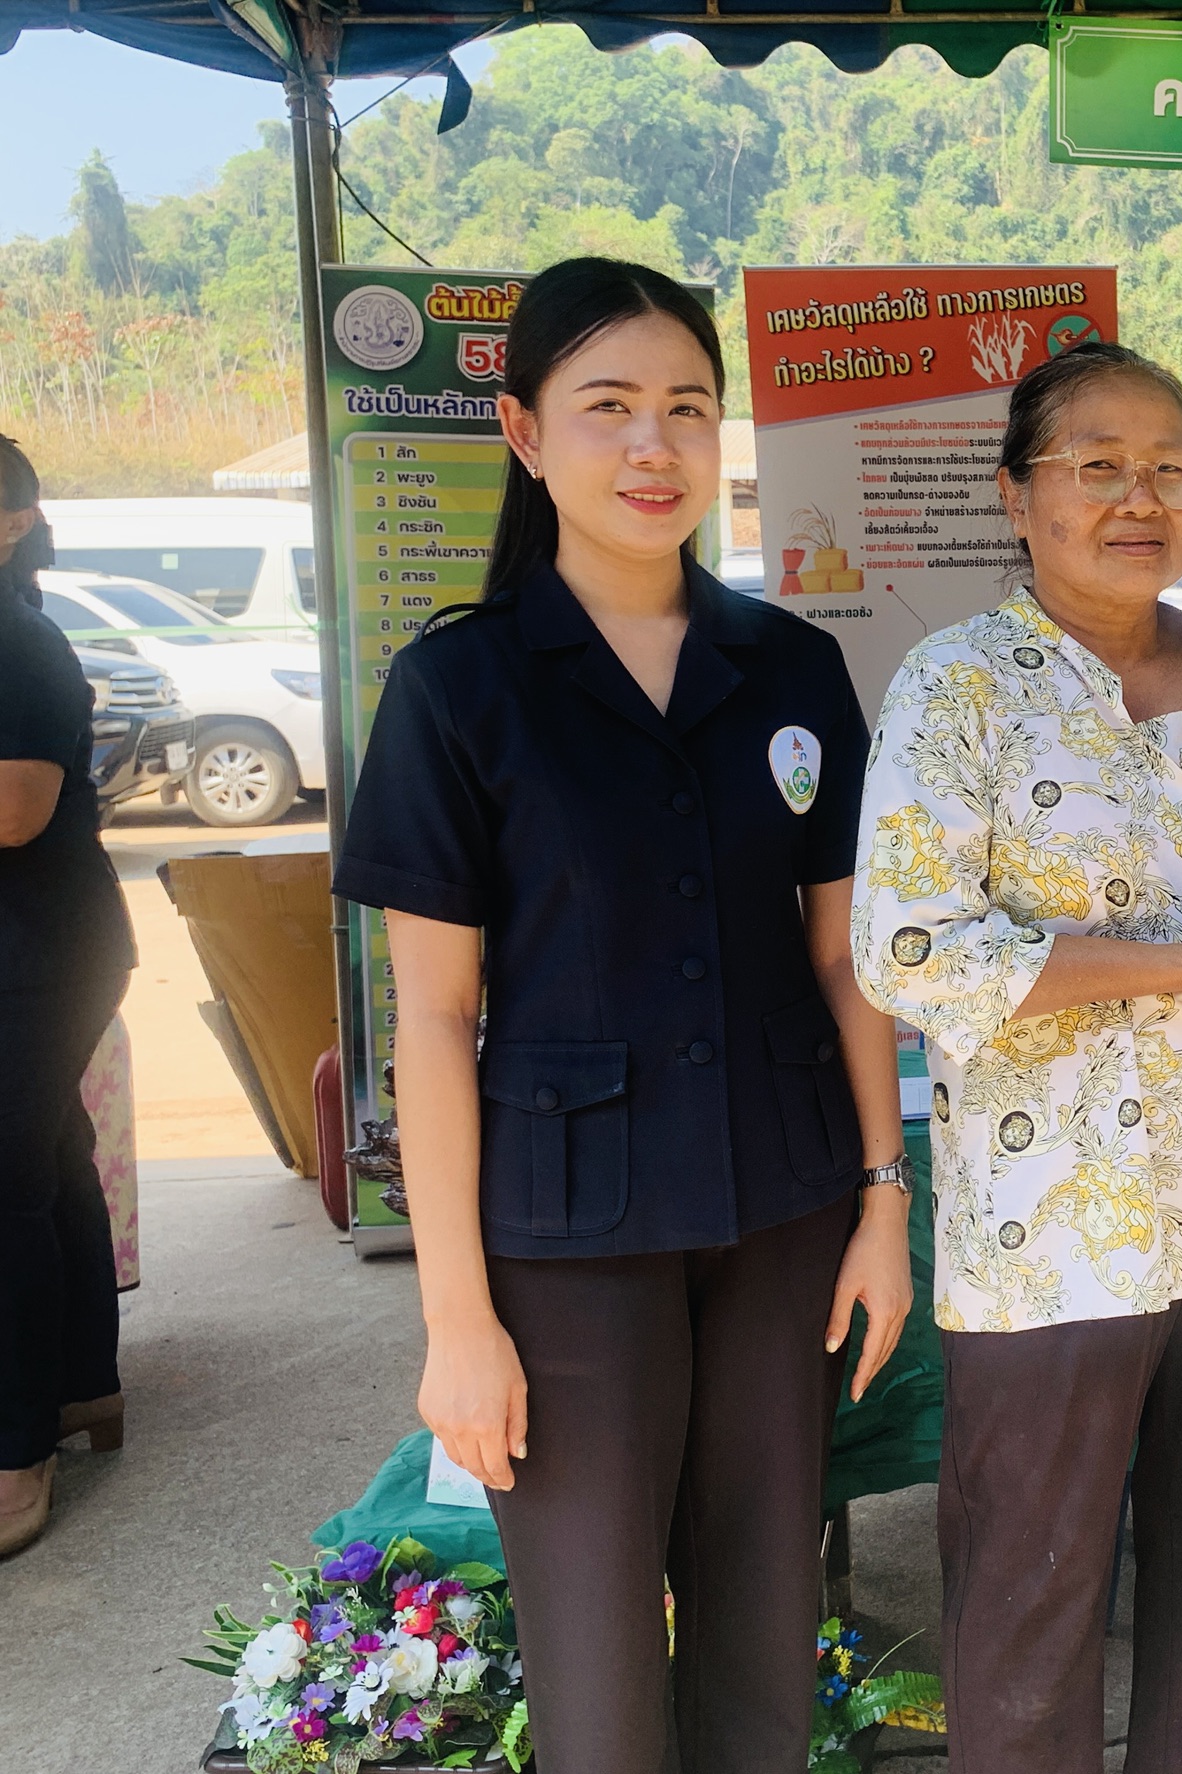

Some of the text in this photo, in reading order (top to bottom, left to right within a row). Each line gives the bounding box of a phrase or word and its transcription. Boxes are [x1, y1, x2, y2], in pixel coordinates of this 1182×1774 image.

[766, 281, 1086, 335] เศษวัสดุเหลือใช้ ทางการเกษตร
[773, 347, 935, 388] ทำอะไรได้บ้าง ?
[378, 445, 416, 460] 1 สัก
[376, 471, 435, 487] 2 พะยูง
[376, 495, 437, 509] 3 ชิงชัน
[376, 521, 386, 532] 4
[378, 545, 388, 557] 5
[379, 570, 389, 581] 6
[380, 595, 432, 606] 7 แดง
[806, 605, 873, 619] ฟางและตอซัง
[381, 620, 391, 631] 8
[382, 645, 392, 656] 9
